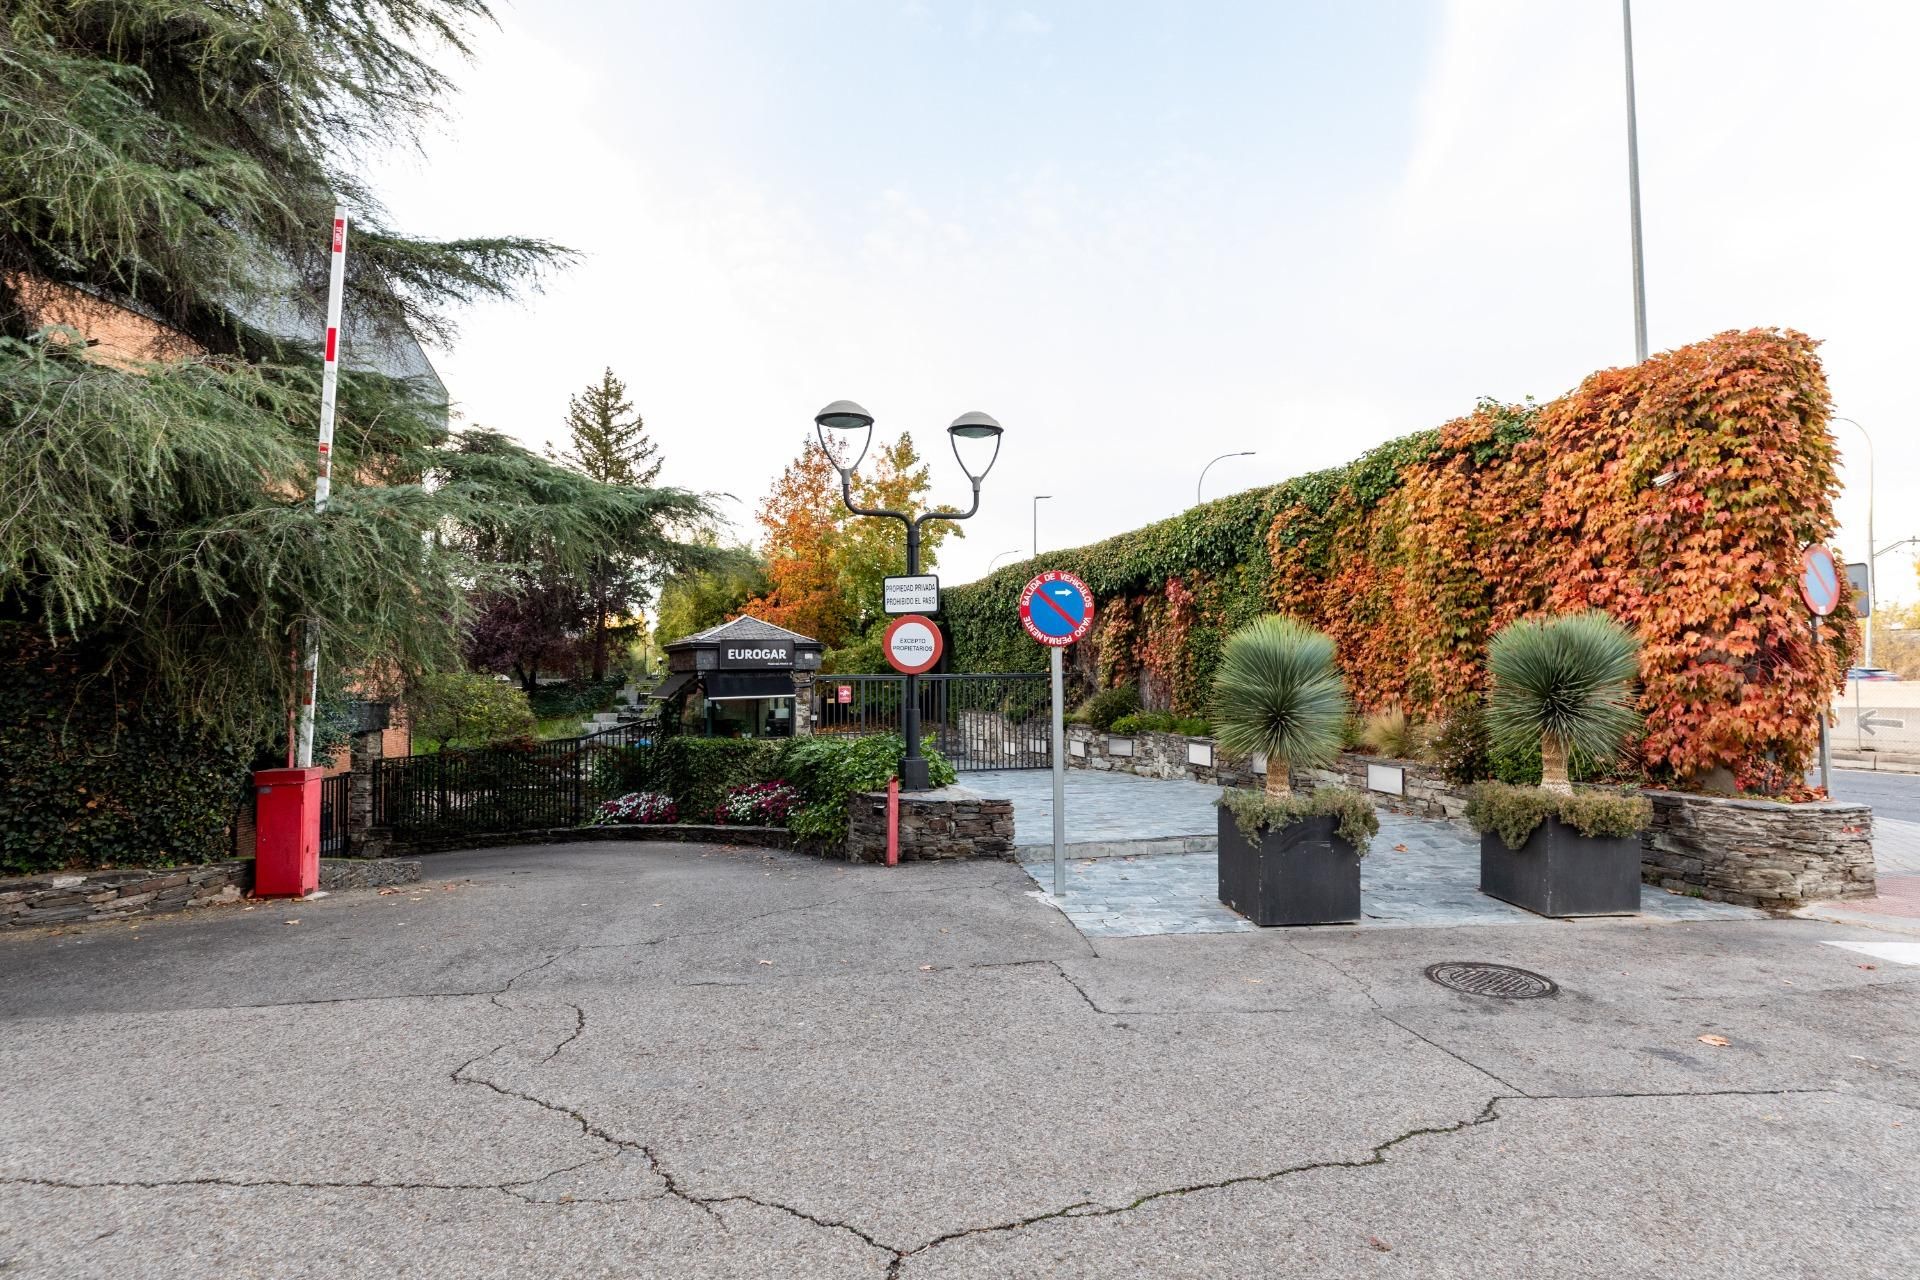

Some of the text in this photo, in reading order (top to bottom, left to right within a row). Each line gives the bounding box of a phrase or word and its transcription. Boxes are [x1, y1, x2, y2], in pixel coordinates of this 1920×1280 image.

[1022, 573, 1092, 607] SALIDA DE VEHICULOS
[922, 597, 935, 605] PASO
[1023, 616, 1091, 644] VADO PERMANENTE
[727, 648, 787, 660] EUROGAR
